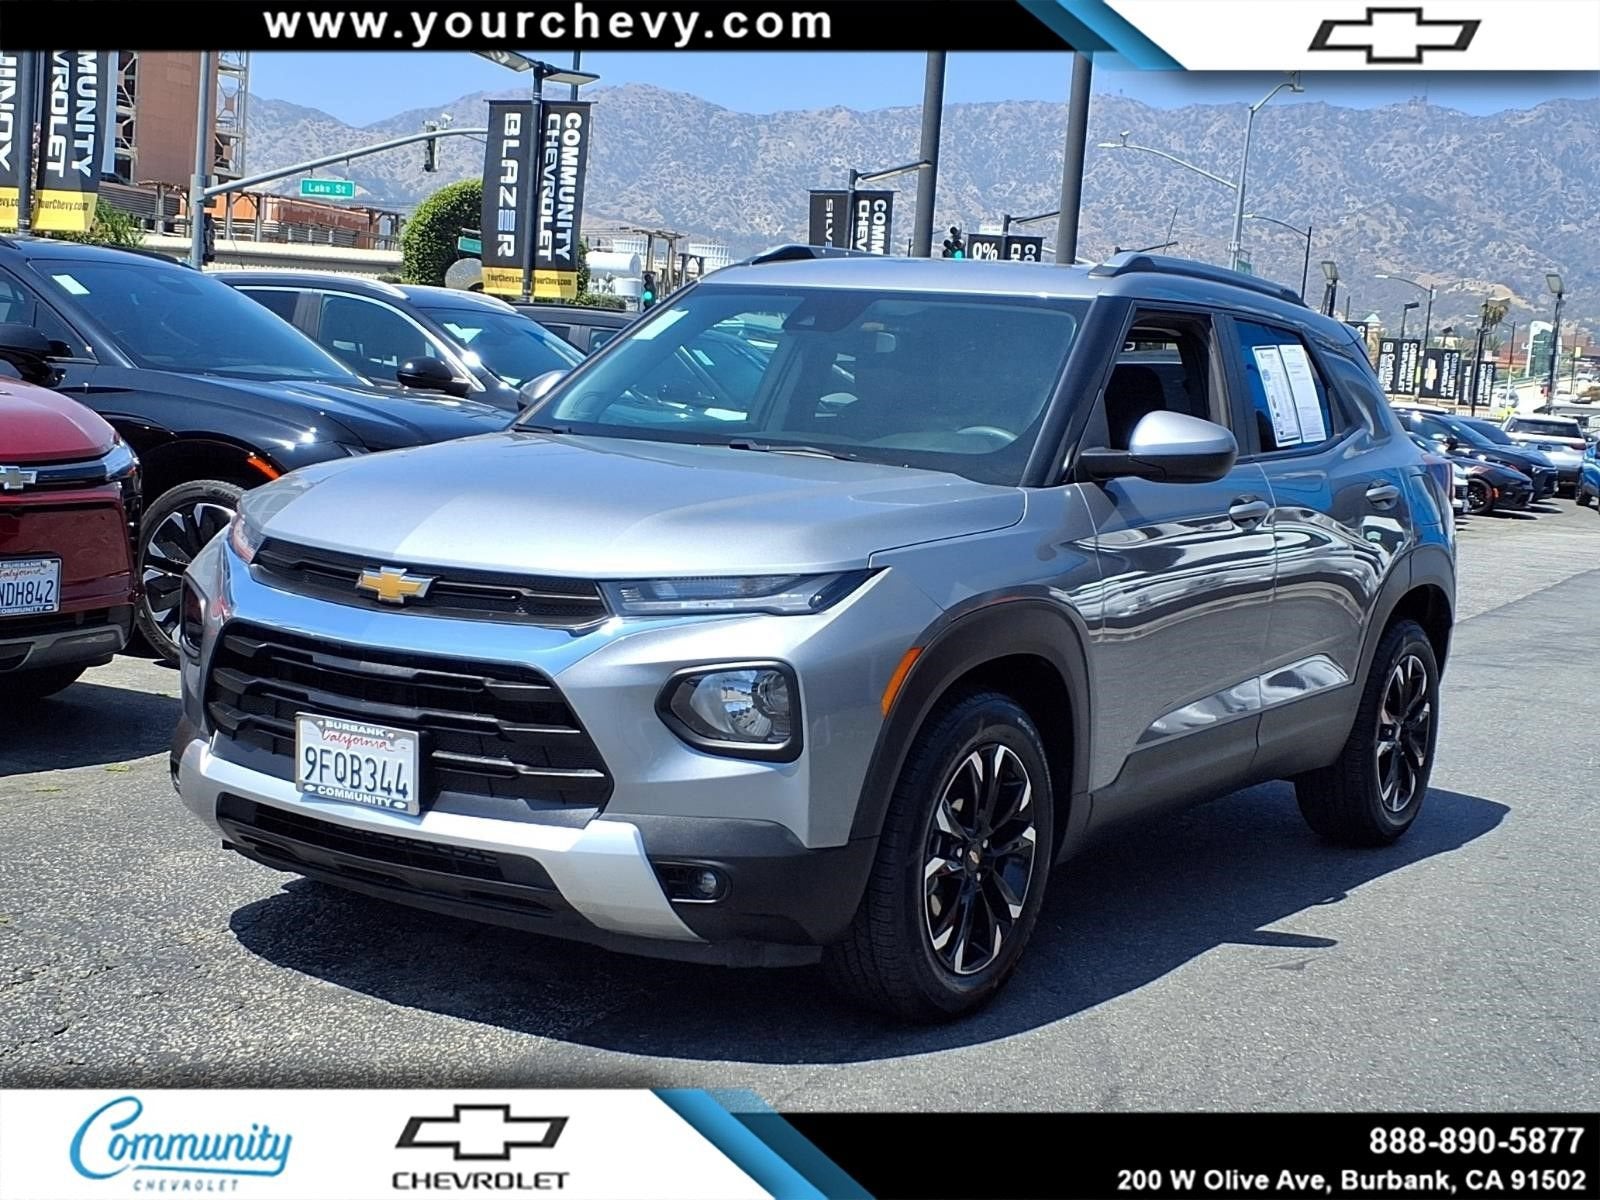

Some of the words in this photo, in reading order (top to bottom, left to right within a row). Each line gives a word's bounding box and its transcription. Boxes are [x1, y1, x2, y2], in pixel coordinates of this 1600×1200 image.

[308, 182, 331, 193] Lake
[335, 184, 346, 194] St
[498, 113, 521, 257] BLAZER
[539, 113, 561, 262] CHEVROLET
[555, 112, 583, 261] COMMUNITY
[856, 200, 870, 252] CHEV
[871, 199, 887, 256] COMM
[972, 242, 998, 261] 0%
[1398, 342, 1410, 393] CHEVROLET
[1406, 342, 1418, 393] COMMUNITY
[325, 719, 385, 737] BURBANK
[304, 746, 409, 799] 9FQB344
[317, 786, 392, 808] COMMUNITY
